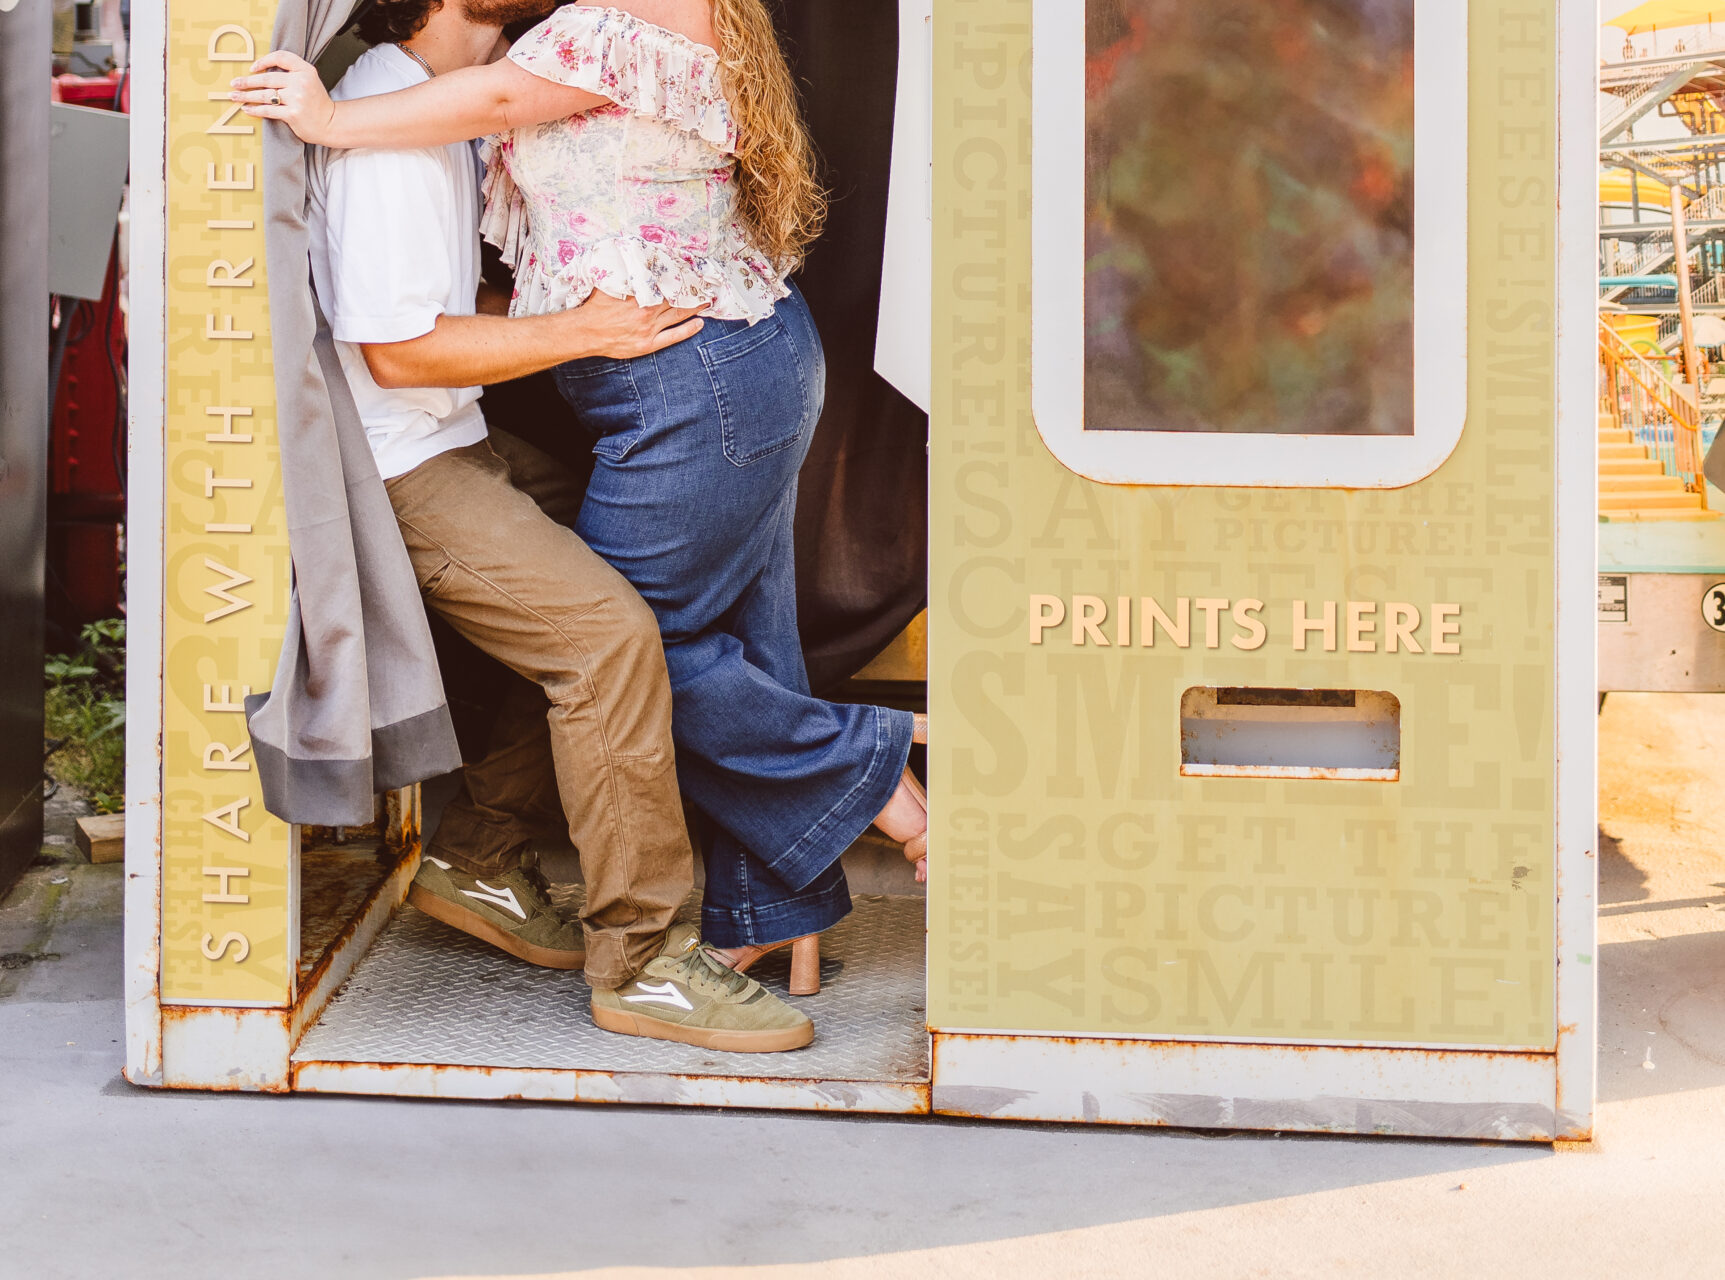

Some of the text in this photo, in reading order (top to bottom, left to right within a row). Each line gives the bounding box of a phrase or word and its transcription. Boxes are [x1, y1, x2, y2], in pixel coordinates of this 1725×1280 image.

[952, 40, 1009, 454] PICTURE!
[203, 406, 255, 624] WITH
[1213, 517, 1474, 558] PICTURE!
[1028, 593, 1463, 656] PRINTS HERE
[202, 684, 252, 963] SHARE
[1098, 812, 1544, 883] GET THE
[1094, 881, 1542, 951] PICTURE!
[1100, 950, 1545, 1039] SMILE!
